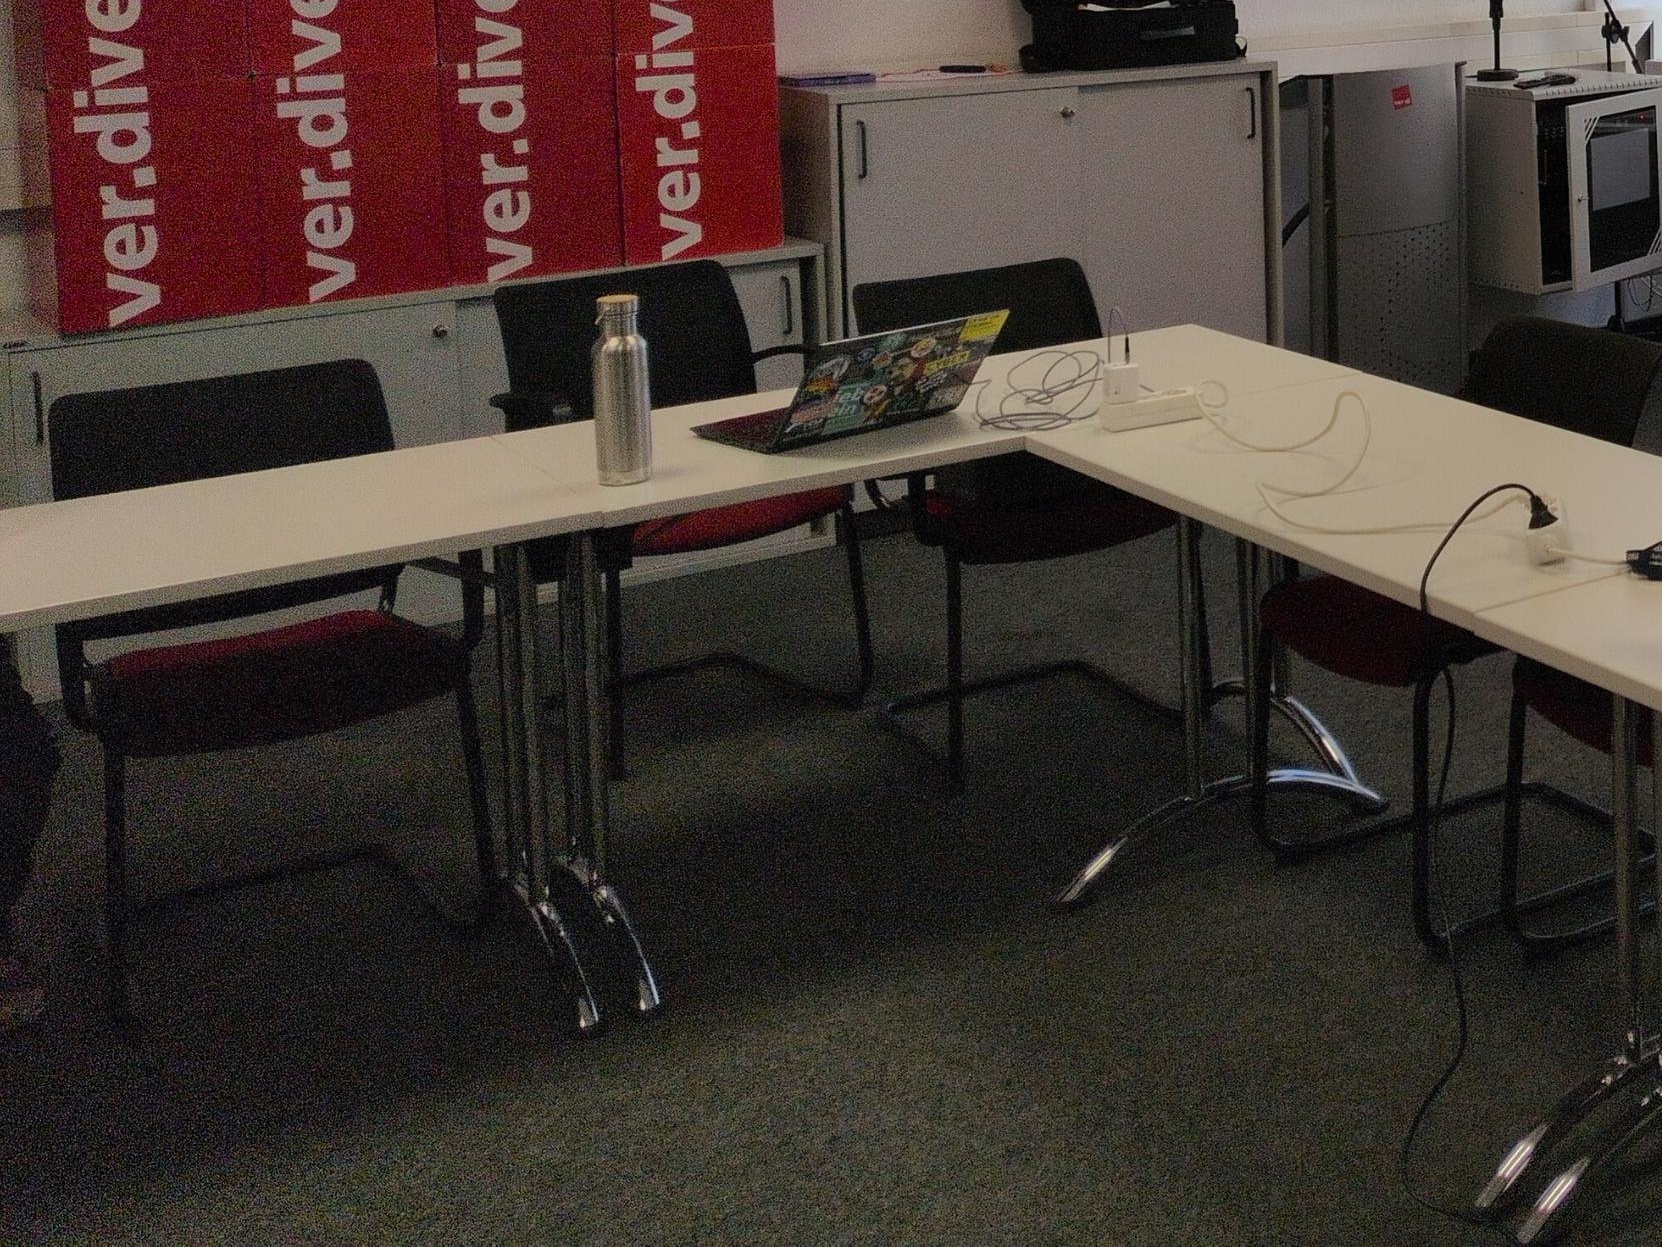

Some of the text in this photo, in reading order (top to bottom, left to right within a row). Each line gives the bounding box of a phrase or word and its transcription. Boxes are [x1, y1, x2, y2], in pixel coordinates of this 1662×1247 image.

[73, 86, 162, 326] ver.di
[276, 73, 357, 303] ver.di
[458, 62, 535, 283] ver.di
[636, 52, 704, 262] ver.di
